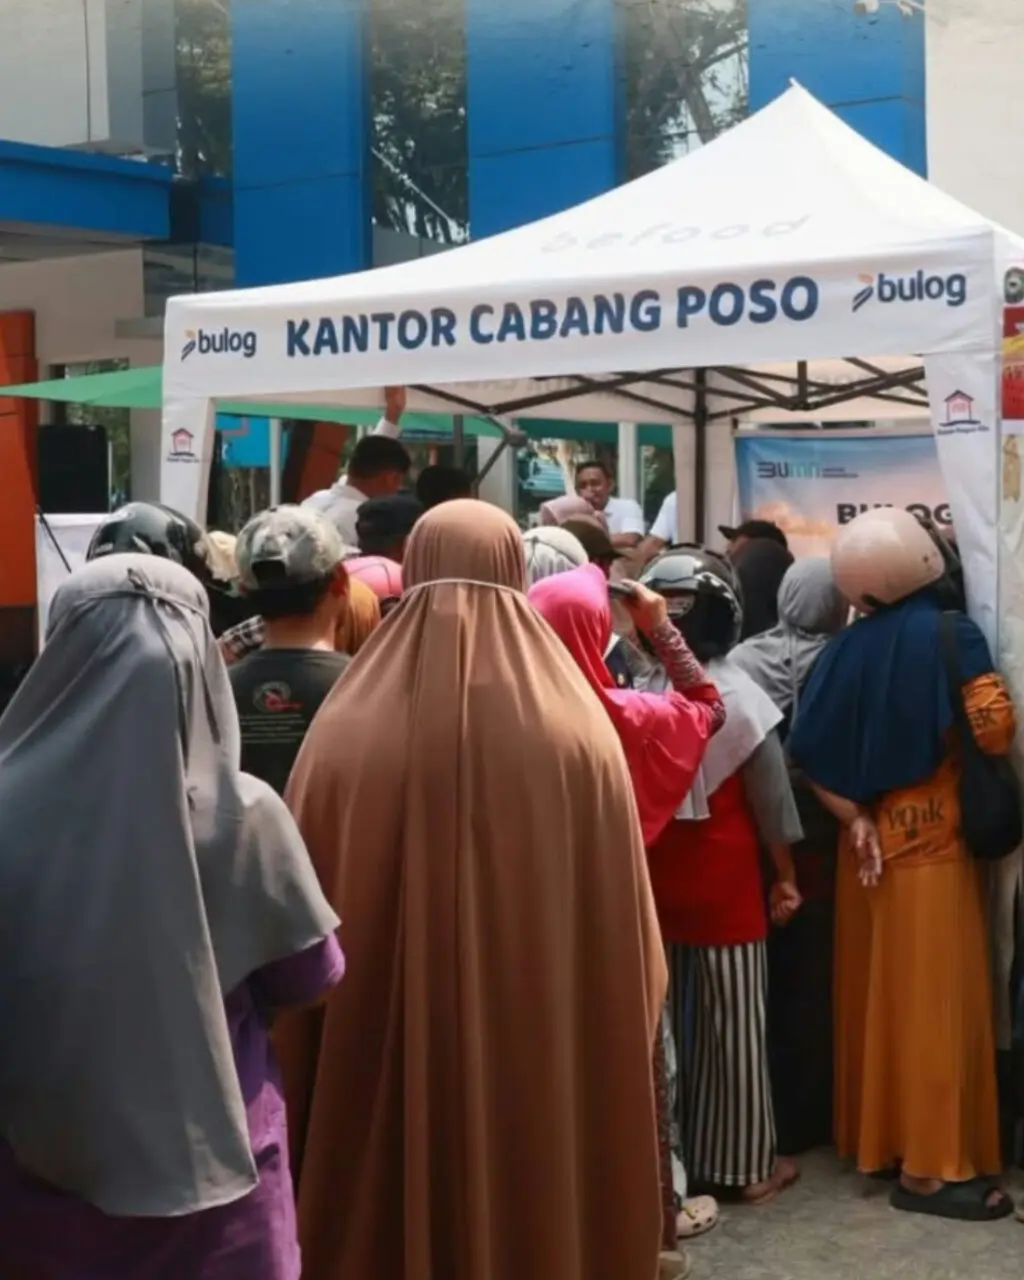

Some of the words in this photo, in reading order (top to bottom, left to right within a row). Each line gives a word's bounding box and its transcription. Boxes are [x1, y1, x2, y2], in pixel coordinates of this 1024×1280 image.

[876, 271, 966, 306] bulog
[285, 308, 455, 356] KANTOR
[470, 291, 661, 343] CABANG
[676, 276, 819, 327] POSO
[198, 329, 257, 357] bulog
